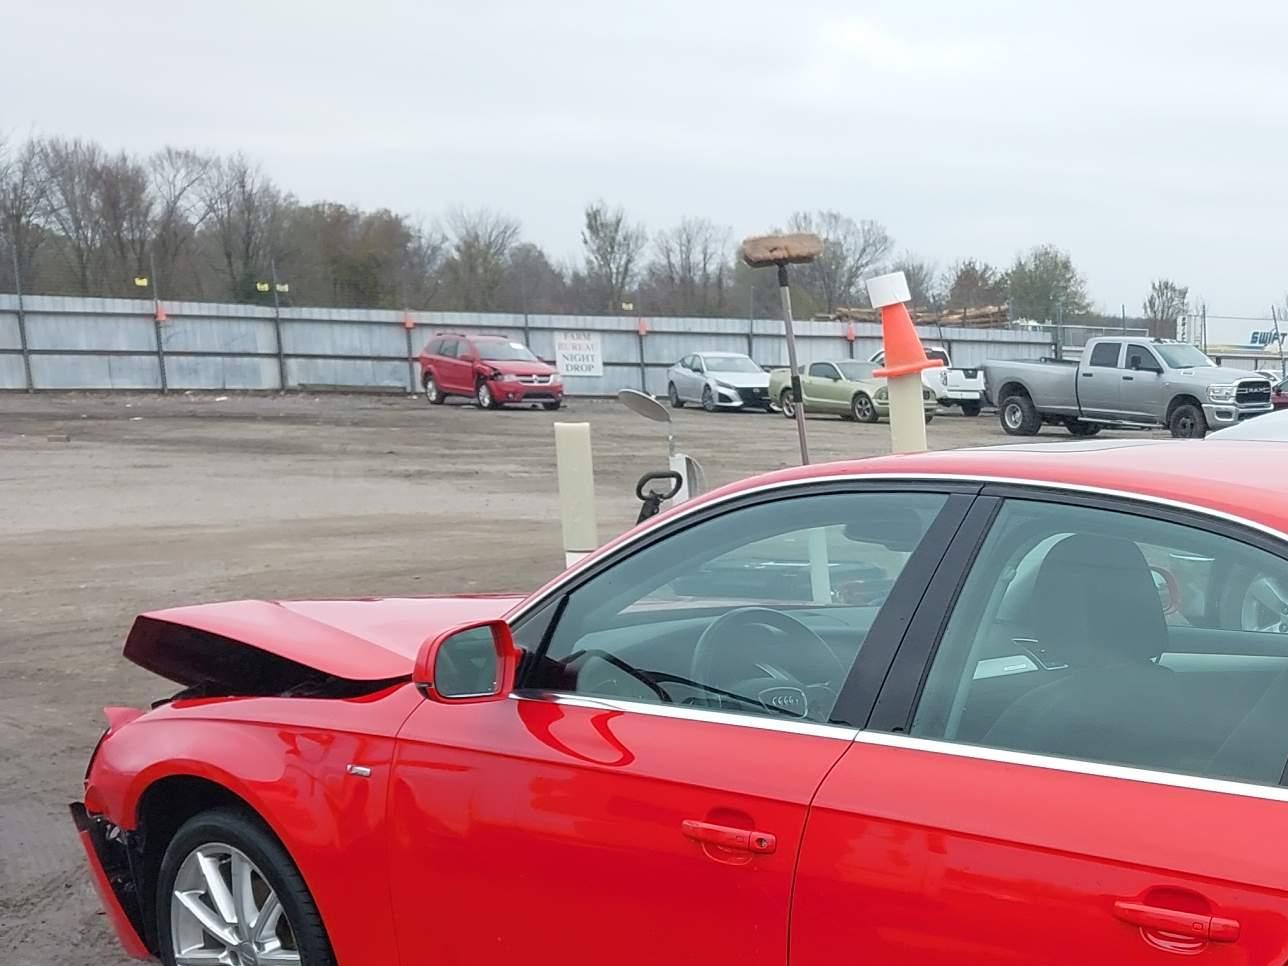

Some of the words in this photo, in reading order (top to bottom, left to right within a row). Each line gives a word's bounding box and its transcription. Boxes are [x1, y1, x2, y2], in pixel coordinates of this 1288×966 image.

[1250, 329, 1288, 345] SWIFT
[562, 353, 595, 362] NIGHT
[565, 363, 594, 372] DROP
